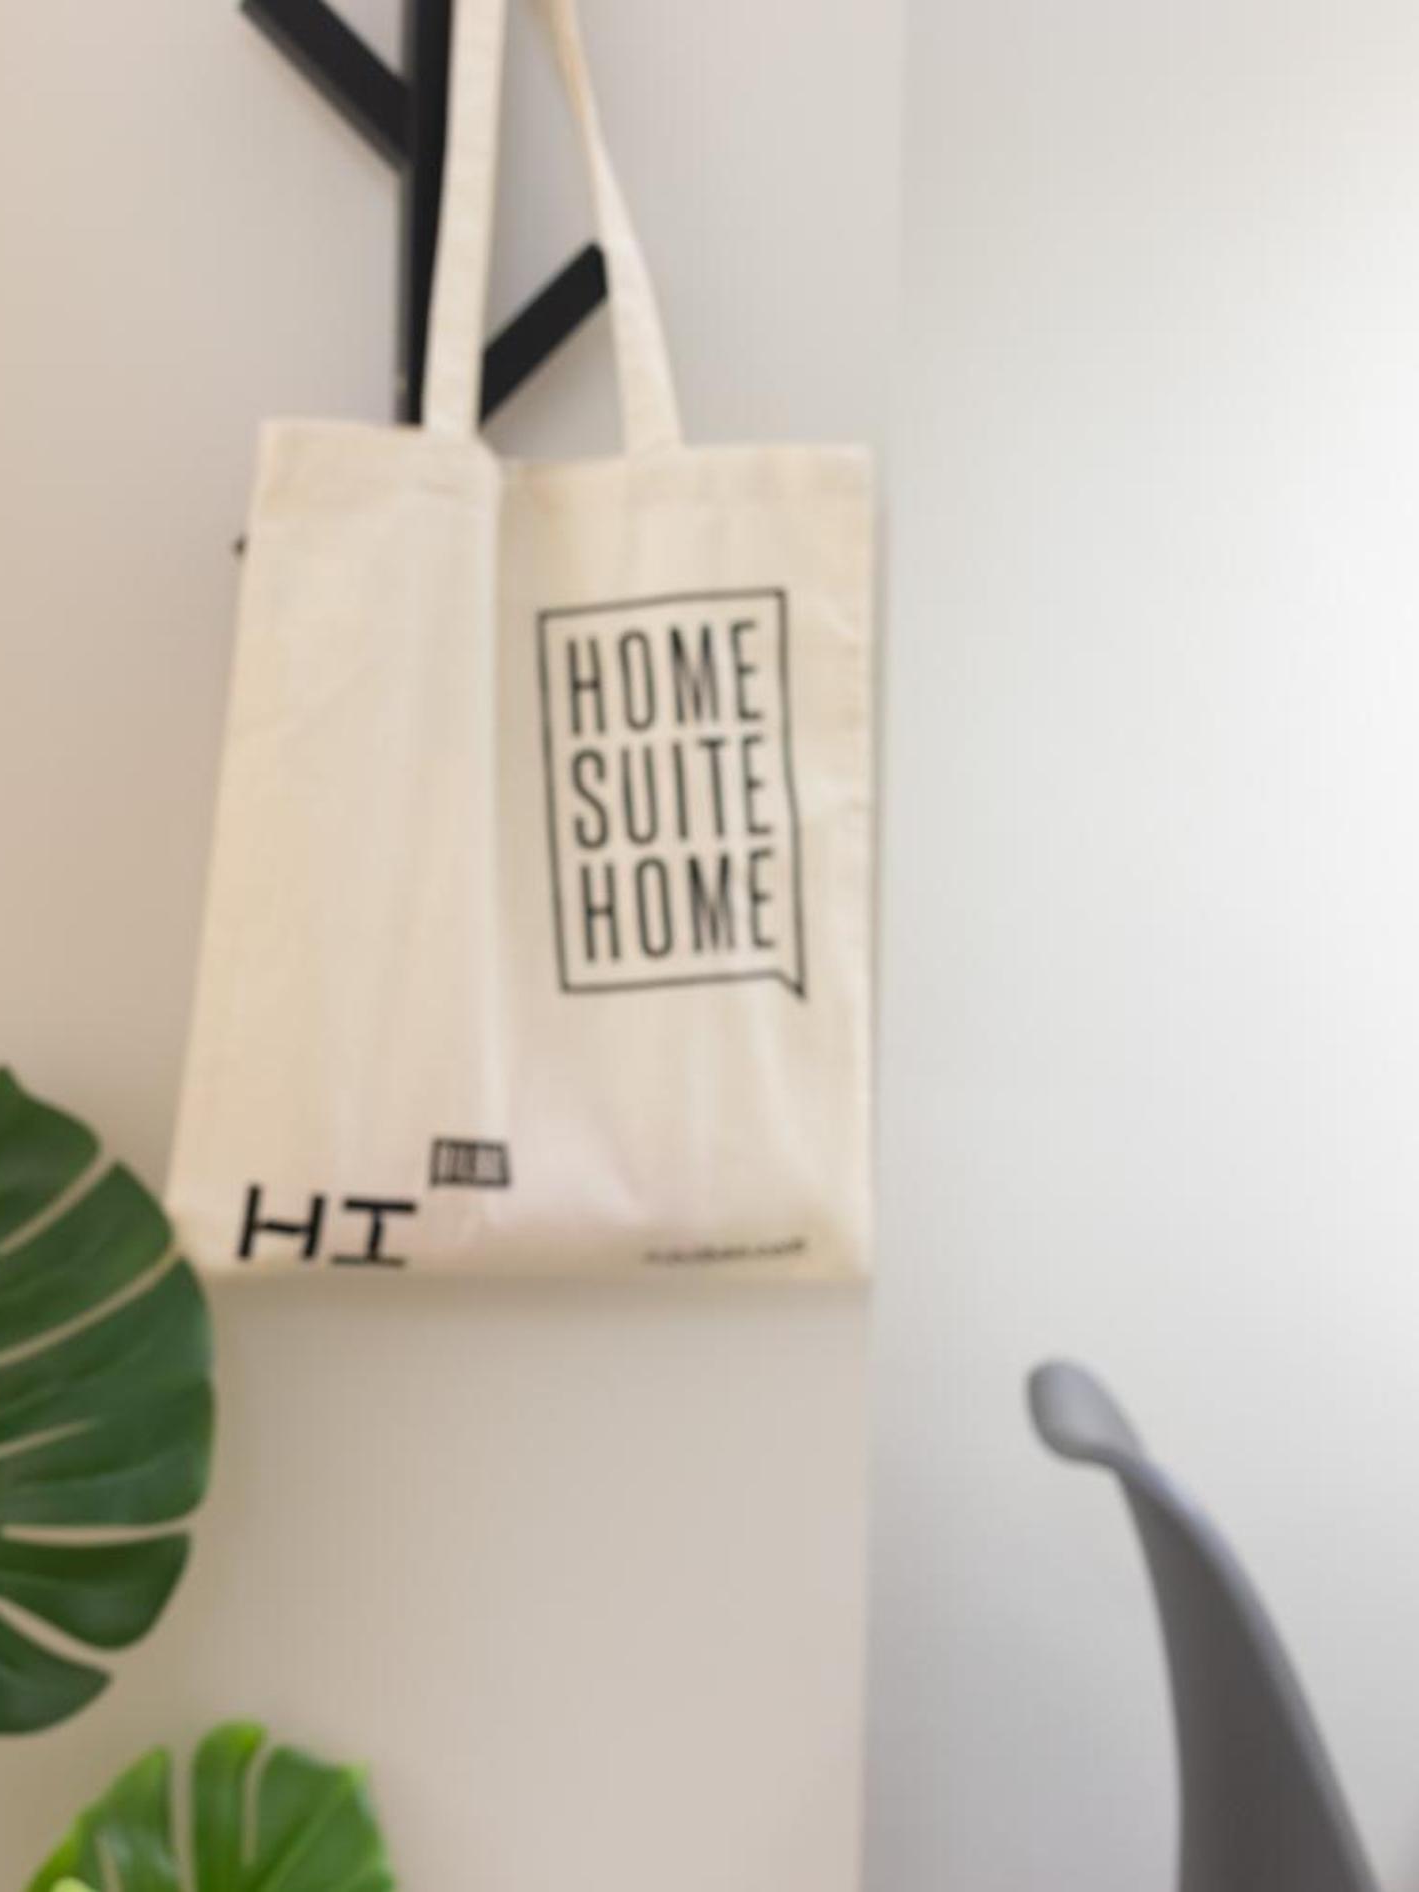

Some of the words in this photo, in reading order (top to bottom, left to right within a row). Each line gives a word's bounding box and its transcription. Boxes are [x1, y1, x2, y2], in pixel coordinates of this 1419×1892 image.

[566, 617, 765, 738] HOME
[570, 734, 774, 851] SUITE
[580, 846, 777, 964] HOME
[237, 1184, 418, 1267] HI
